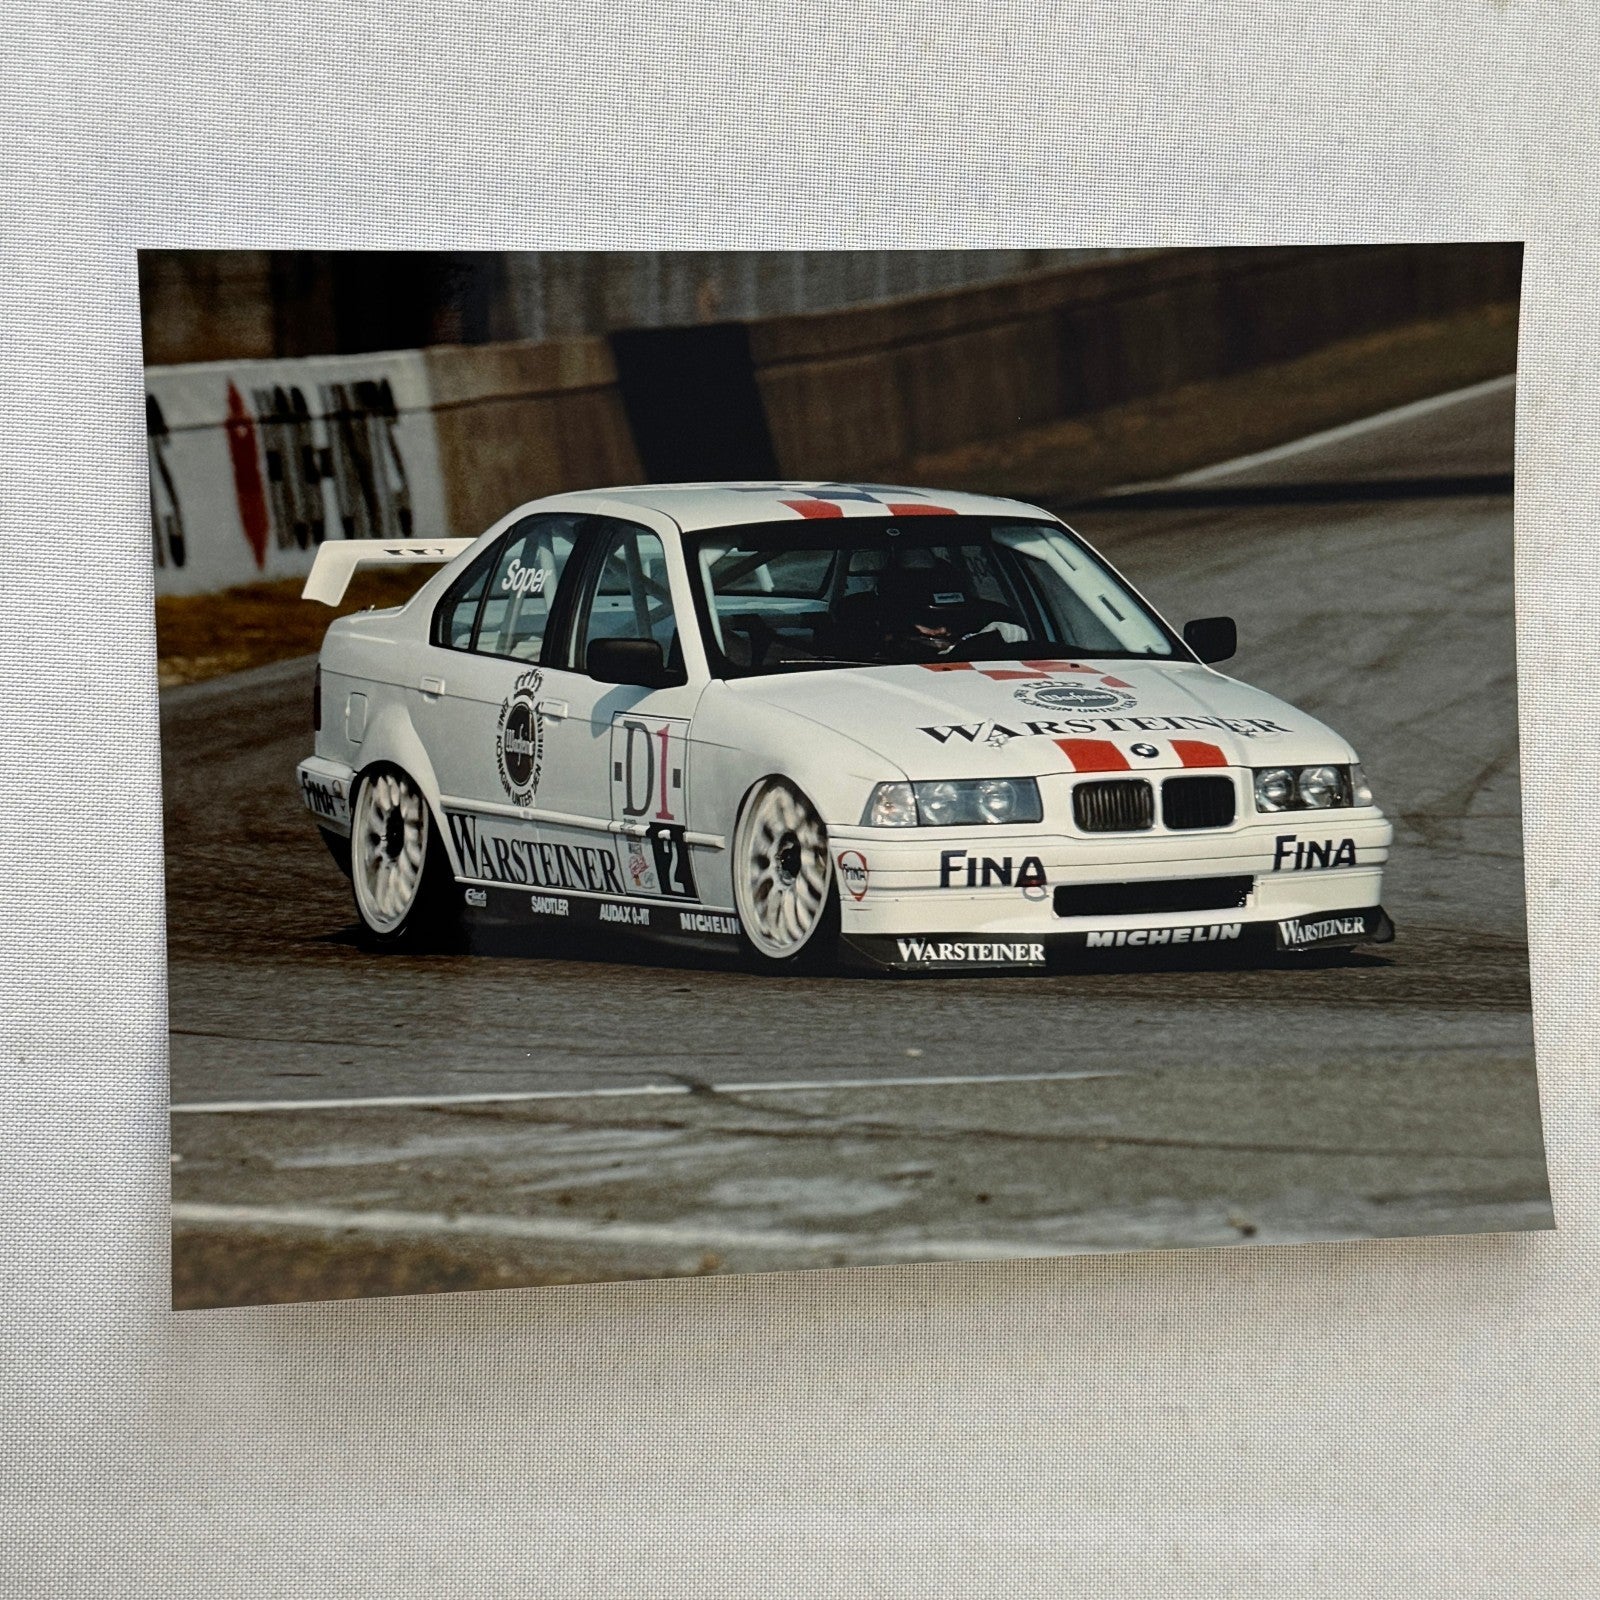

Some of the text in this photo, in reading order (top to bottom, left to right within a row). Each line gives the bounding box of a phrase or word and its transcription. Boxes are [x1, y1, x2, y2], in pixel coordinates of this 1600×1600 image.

[501, 558, 553, 599] Soper
[915, 716, 1294, 745] WARSTEINER
[623, 720, 675, 821] D1
[445, 812, 626, 895] WARSTEINER
[658, 829, 687, 894] 2
[940, 850, 1048, 888] FINA
[1273, 834, 1357, 872] FINA
[679, 912, 741, 935] MICHELIN
[1086, 923, 1242, 948] MICHELIN
[1278, 916, 1365, 947] WARSTEINER
[897, 937, 1046, 962] WARSTEINER
